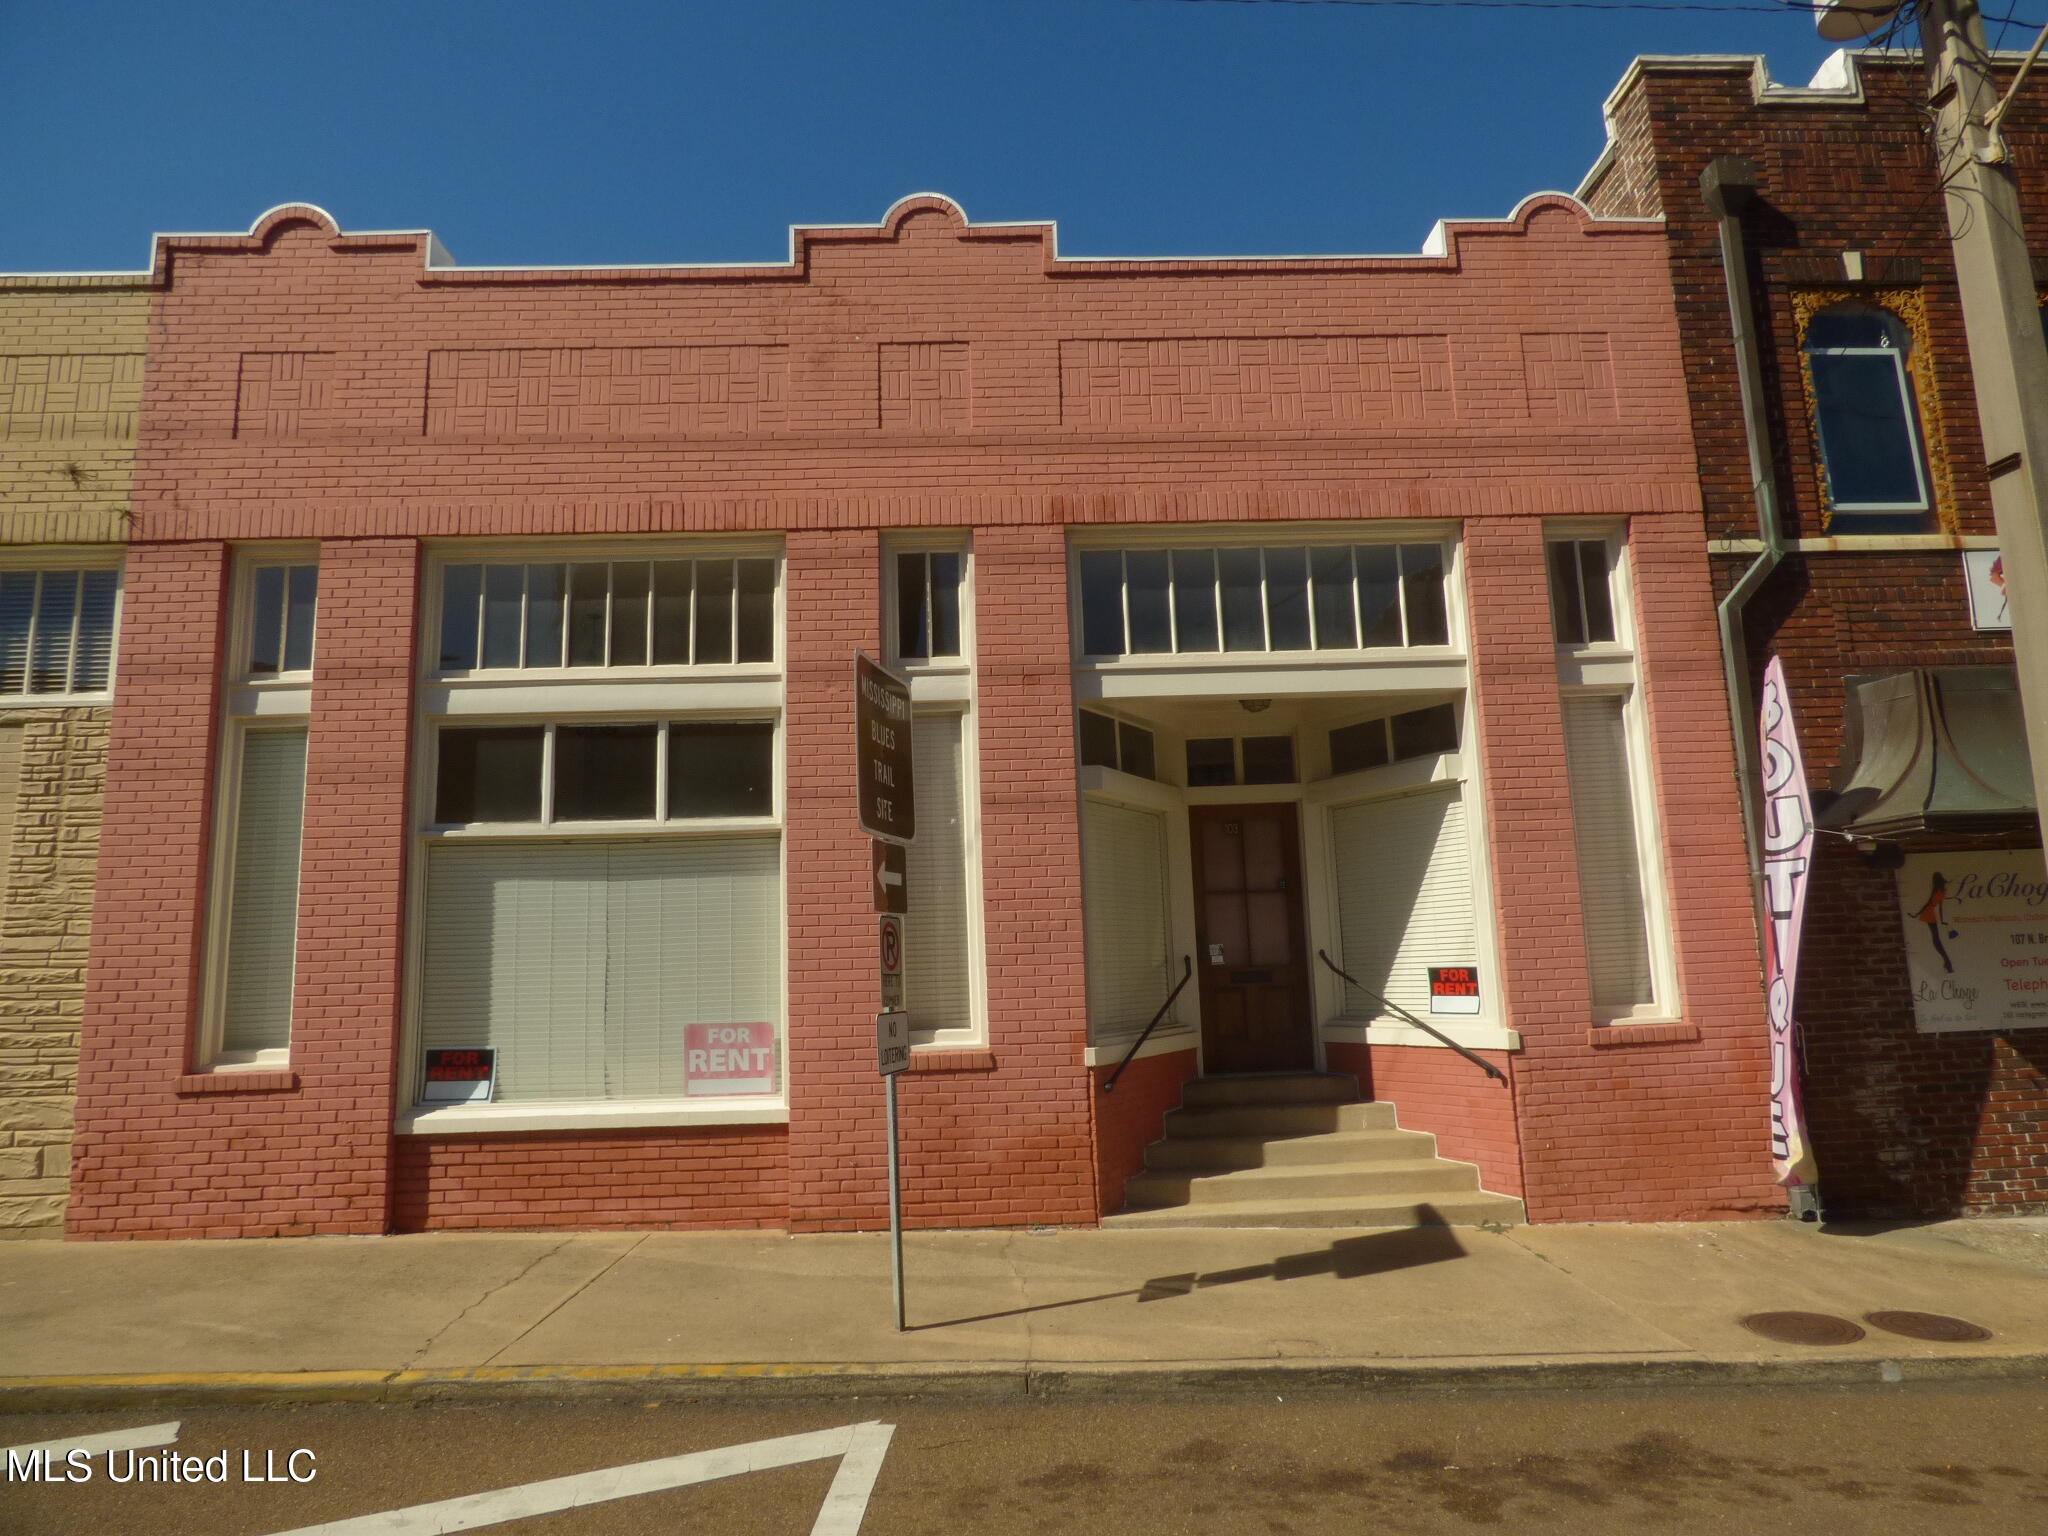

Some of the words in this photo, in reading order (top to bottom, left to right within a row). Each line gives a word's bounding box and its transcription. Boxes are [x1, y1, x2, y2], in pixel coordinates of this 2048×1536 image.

[861, 674, 905, 721] MISSISSIPPI
[871, 719, 895, 750] BLUES
[873, 759, 895, 788] TRAIL
[876, 796, 893, 822] SITE
[2000, 957, 2029, 969] Open
[1439, 968, 1469, 982] FOR
[1432, 982, 1478, 996] RENT
[707, 1027, 750, 1044] FOR
[888, 1021, 897, 1038] NO
[440, 1051, 480, 1065] FOR
[688, 1047, 770, 1073] RENT
[881, 1045, 908, 1066] LOITERING
[429, 1065, 490, 1081] RENT
